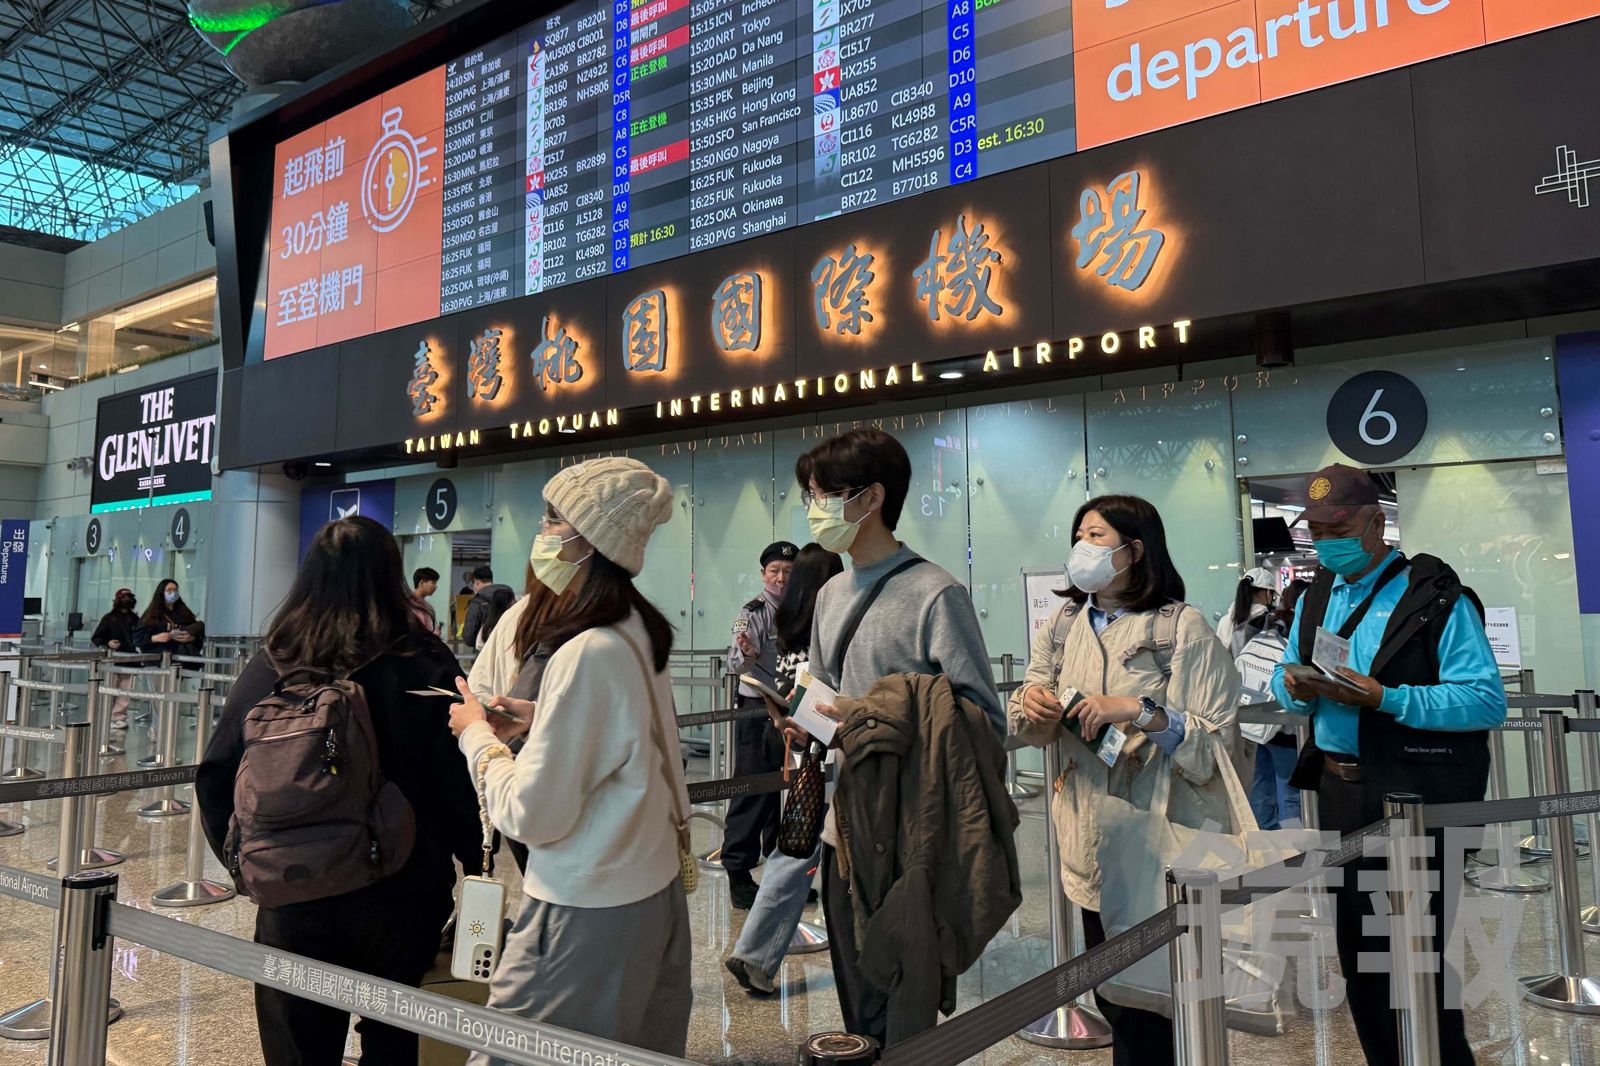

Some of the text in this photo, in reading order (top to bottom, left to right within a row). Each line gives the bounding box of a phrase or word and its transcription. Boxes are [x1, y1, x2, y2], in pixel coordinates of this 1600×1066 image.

[545, 27, 569, 47] SQ877
[577, 10, 606, 31] BR2201
[616, 4, 627, 15] D5
[691, 1, 714, 18] 15:05
[691, 10, 733, 38] 15:15 ICN
[545, 41, 576, 63] MU5008
[577, 29, 604, 49] CI8001
[616, 18, 628, 32] D8
[545, 36, 626, 80] CA196 BR2782 D1
[690, 13, 874, 94] 15:30 MNL Manila BR277
[690, 97, 714, 114] 15:35
[716, 88, 733, 104] PEK
[742, 75, 773, 95] Beijing
[840, 36, 871, 59] CI517
[952, 1, 969, 19] A8
[691, 16, 770, 56] 15:20 NRT Tokyo
[691, 31, 783, 75] 15:20 DAD Da Nang
[544, 55, 667, 115] BR196 NH5806 C7 正在登機
[545, 79, 567, 97] BR160
[577, 63, 608, 85] NZ4922
[616, 55, 627, 68] C6
[690, 23, 969, 133] 15:45 HKG Hong Kong HX255 C5
[544, 90, 630, 132] JX703 D5R
[690, 46, 971, 152] 15:50 SFO San Francisco UA852 D6
[690, 68, 975, 171] 15:50 NGO Nagoya JL8670 CI8340 D10
[544, 109, 627, 149] BR277 C8
[544, 112, 667, 166] CI517 A8 正在登機
[690, 93, 971, 191] 16:25 FUK Fukuoka CI116 KL4988 A9
[283, 135, 345, 199] 起飛前
[544, 146, 627, 183] HX255 BR2899 C5
[544, 183, 568, 200] UA852
[616, 164, 627, 177] D6
[690, 115, 976, 210] 16:25 FUK Fukuoka BR102 TG6282 C5R
[690, 118, 1044, 230] 16:25 OKA Okinawa CI122 MH5596 D3 est. 16:30
[543, 201, 568, 218] JL8670
[576, 189, 603, 207] CI8340
[613, 182, 629, 196] D10
[543, 201, 627, 235] CI116 JL5128 A9
[690, 162, 972, 249] 16:30 PVG Shanghai BR722 B77018 C4
[280, 201, 349, 260] 30分鐘
[543, 224, 675, 270] CI122 KL4980 D3 預計 16:30
[544, 219, 629, 252] BR102 TG6282 C5R
[276, 264, 363, 327] 至登機門
[441, 256, 626, 313] 16:30 PVG BR722 CA5522 C4
[140, 387, 174, 424] THE
[404, 319, 1191, 454] TAIWAN TAOYUAN INTERNATIONAL AIRPORT
[1358, 388, 1398, 446] 6
[99, 414, 216, 481] GLENLIVET
[435, 488, 448, 520] 5
[90, 524, 97, 547] 3
[176, 516, 183, 540] 4
[0, 541, 12, 585] Departures
[147, 770, 184, 783] Taiwan
[719, 783, 750, 796] Airport
[21, 877, 49, 899] Airport
[1141, 919, 1170, 949] Taiwan
[263, 952, 389, 1016] 臺灣桃園國際機場
[391, 989, 448, 1030] Taiwan
[454, 1007, 529, 1052] Taoyuan
